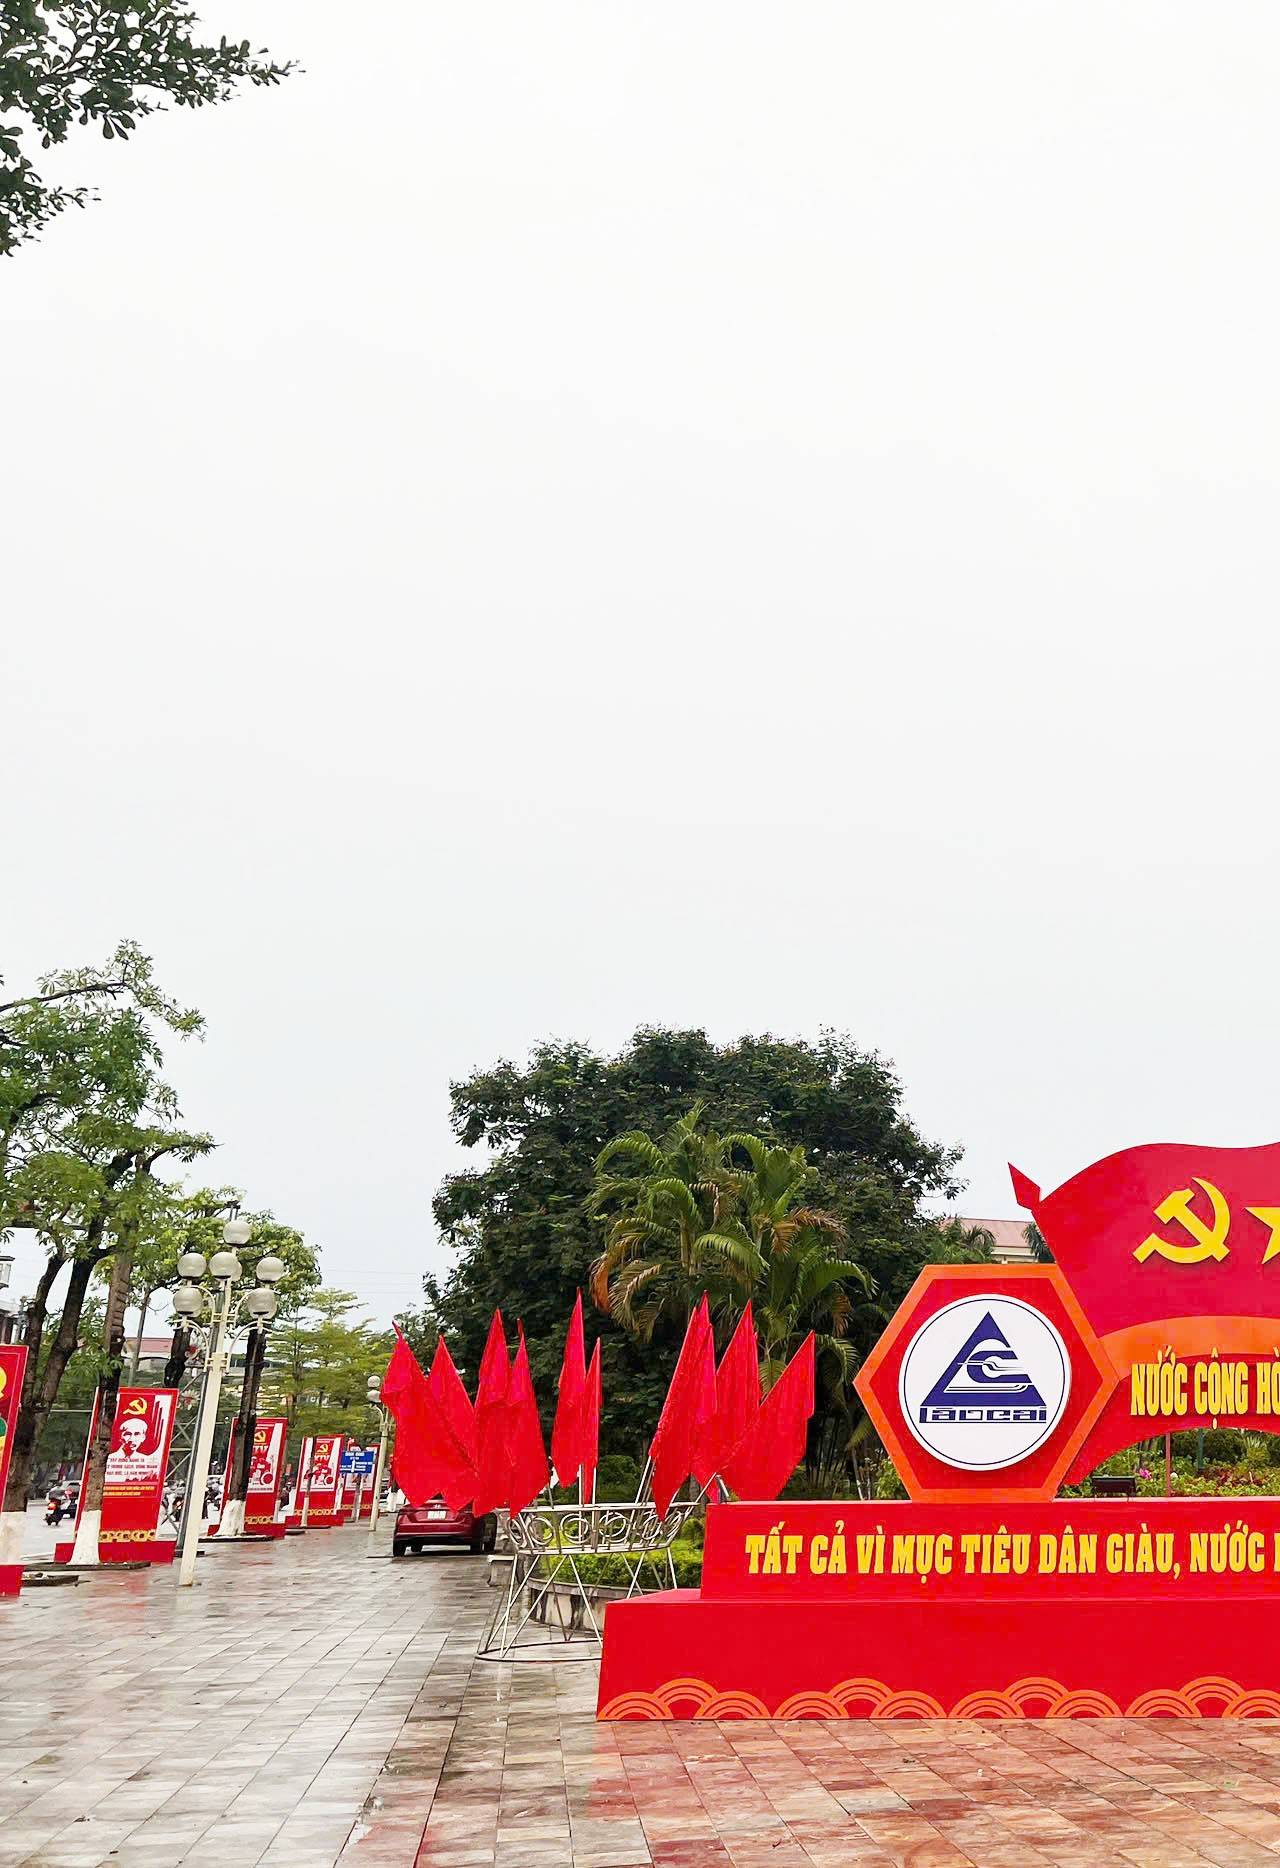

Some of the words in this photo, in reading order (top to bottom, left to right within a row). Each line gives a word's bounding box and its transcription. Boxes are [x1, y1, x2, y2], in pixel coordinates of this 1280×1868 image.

[1130, 1345, 1188, 1416] NƯỚC
[1194, 1347, 1248, 1430] CỘNG
[746, 1522, 802, 1574] TẤT
[809, 1520, 847, 1574] CẢ
[856, 1524, 885, 1574] VÌ
[891, 1533, 953, 1584] MỤC
[961, 1525, 1030, 1574] TIÊU
[1038, 1525, 1097, 1574] DÂN
[1105, 1523, 1180, 1580] GIÀU,
[1189, 1520, 1265, 1574] NƯỚC
